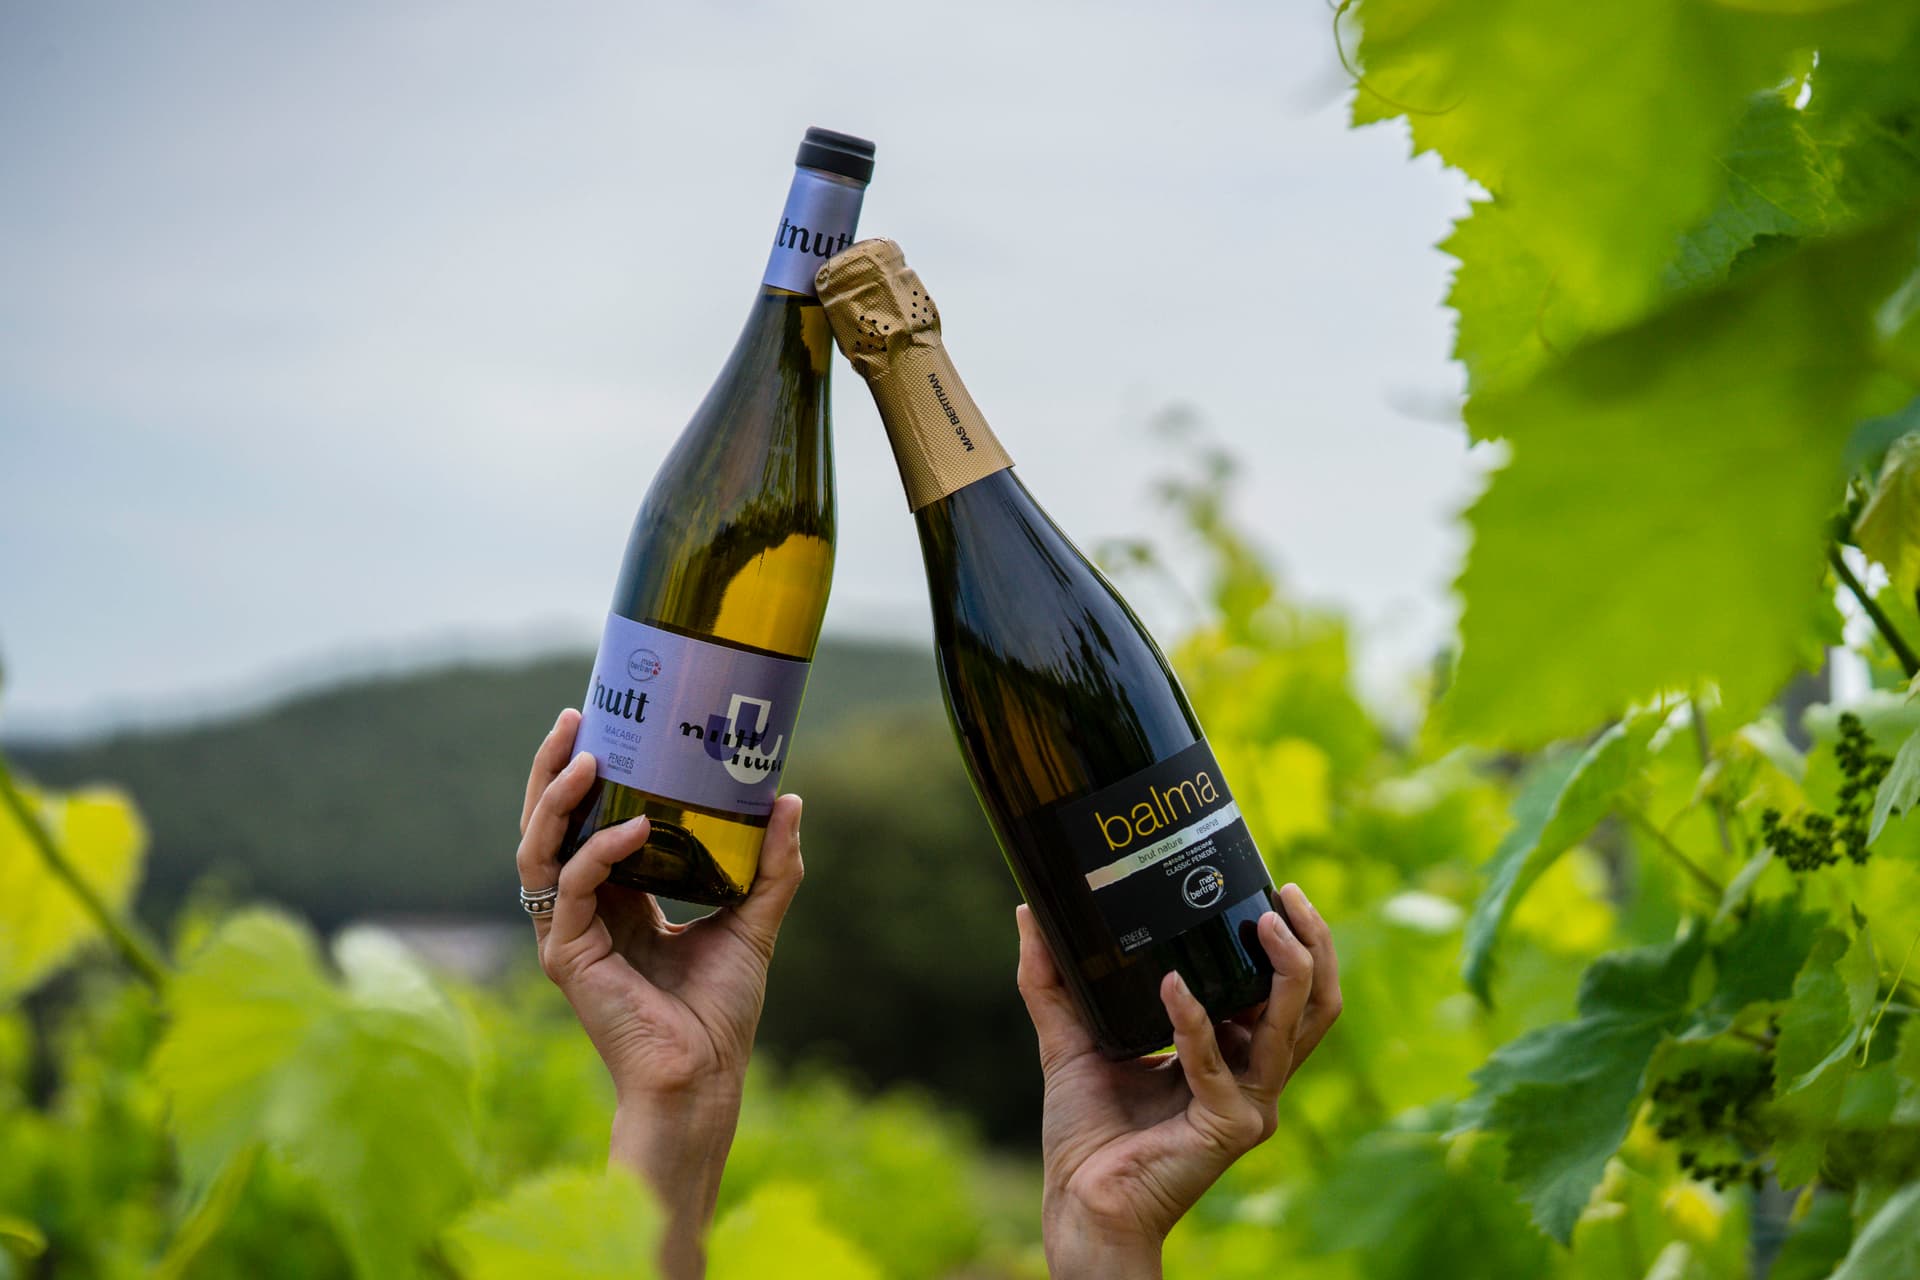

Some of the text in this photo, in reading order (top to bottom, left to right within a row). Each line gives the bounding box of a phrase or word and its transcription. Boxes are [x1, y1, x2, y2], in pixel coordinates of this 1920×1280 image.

[928, 372, 975, 452] MAS BERTRAN
[1095, 771, 1219, 851] balma
[1138, 849, 1157, 864] brut
[1157, 836, 1183, 856] nature
[1165, 859, 1192, 876] CLASSIC
[1189, 881, 1218, 900] bertran
[1199, 873, 1215, 886] mas
